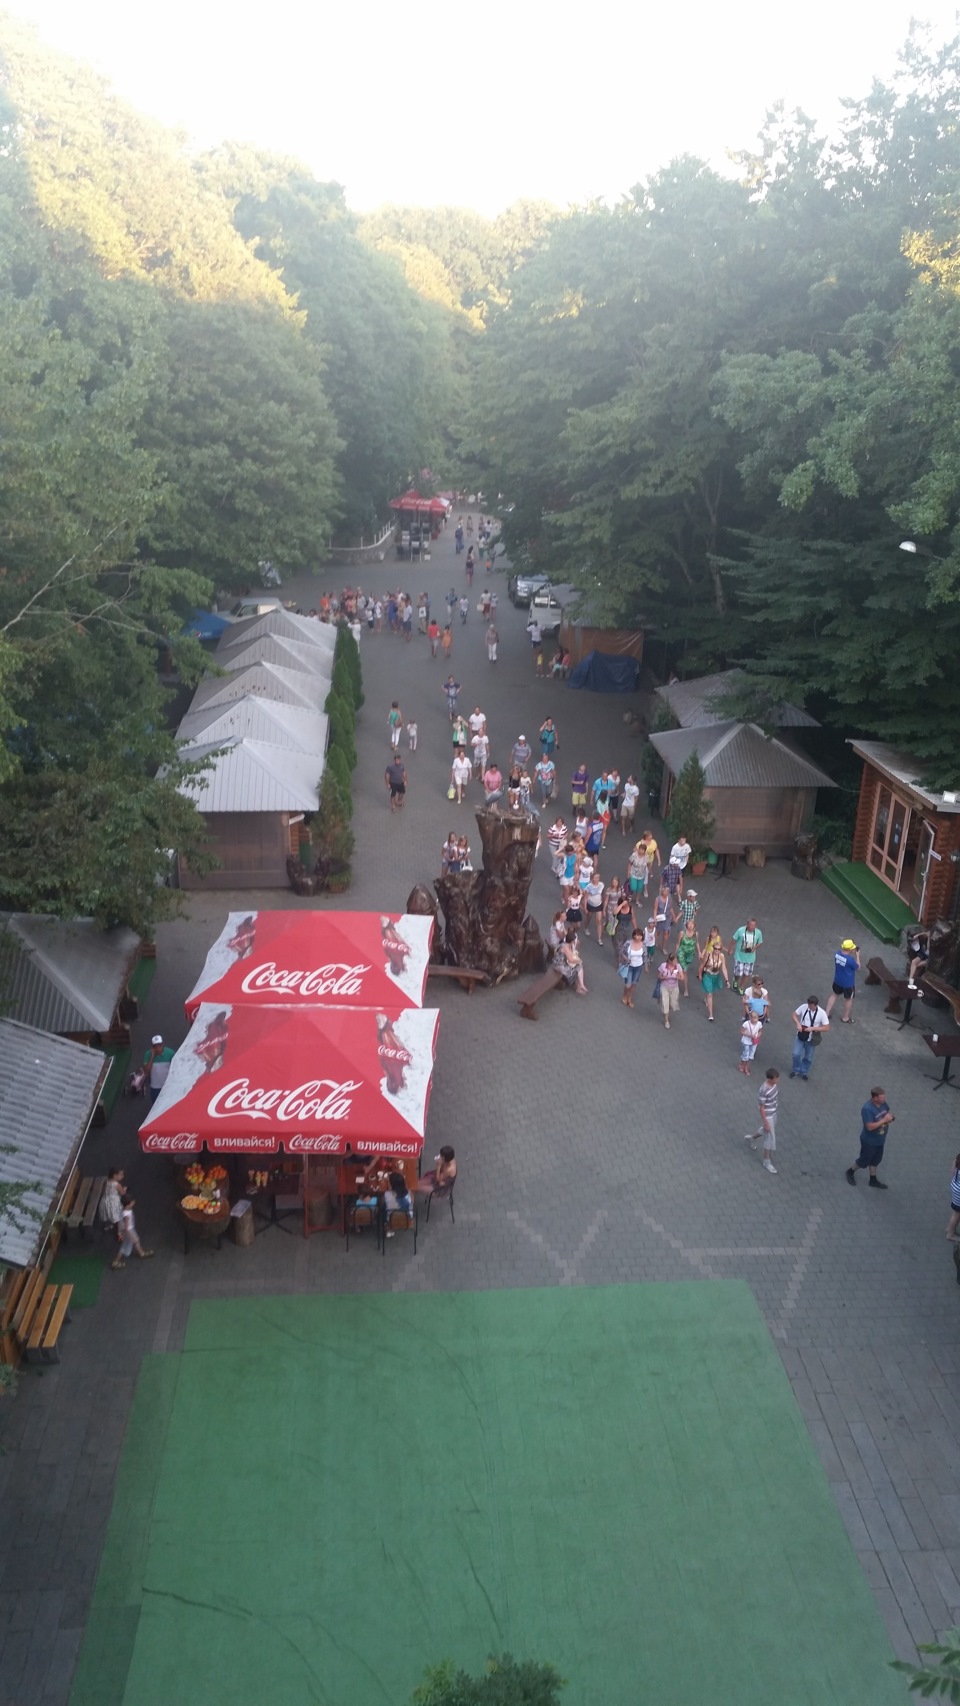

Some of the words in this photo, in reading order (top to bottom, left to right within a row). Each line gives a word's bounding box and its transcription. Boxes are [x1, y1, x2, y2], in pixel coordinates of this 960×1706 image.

[241, 962, 372, 996] Coca-Cola
[207, 1078, 364, 1121] Coca-Cola
[145, 1132, 199, 1150] Coca-Cola
[214, 1136, 275, 1149] вливайся!
[289, 1133, 343, 1151] Coca-Cola
[357, 1139, 418, 1154] вливайся!
